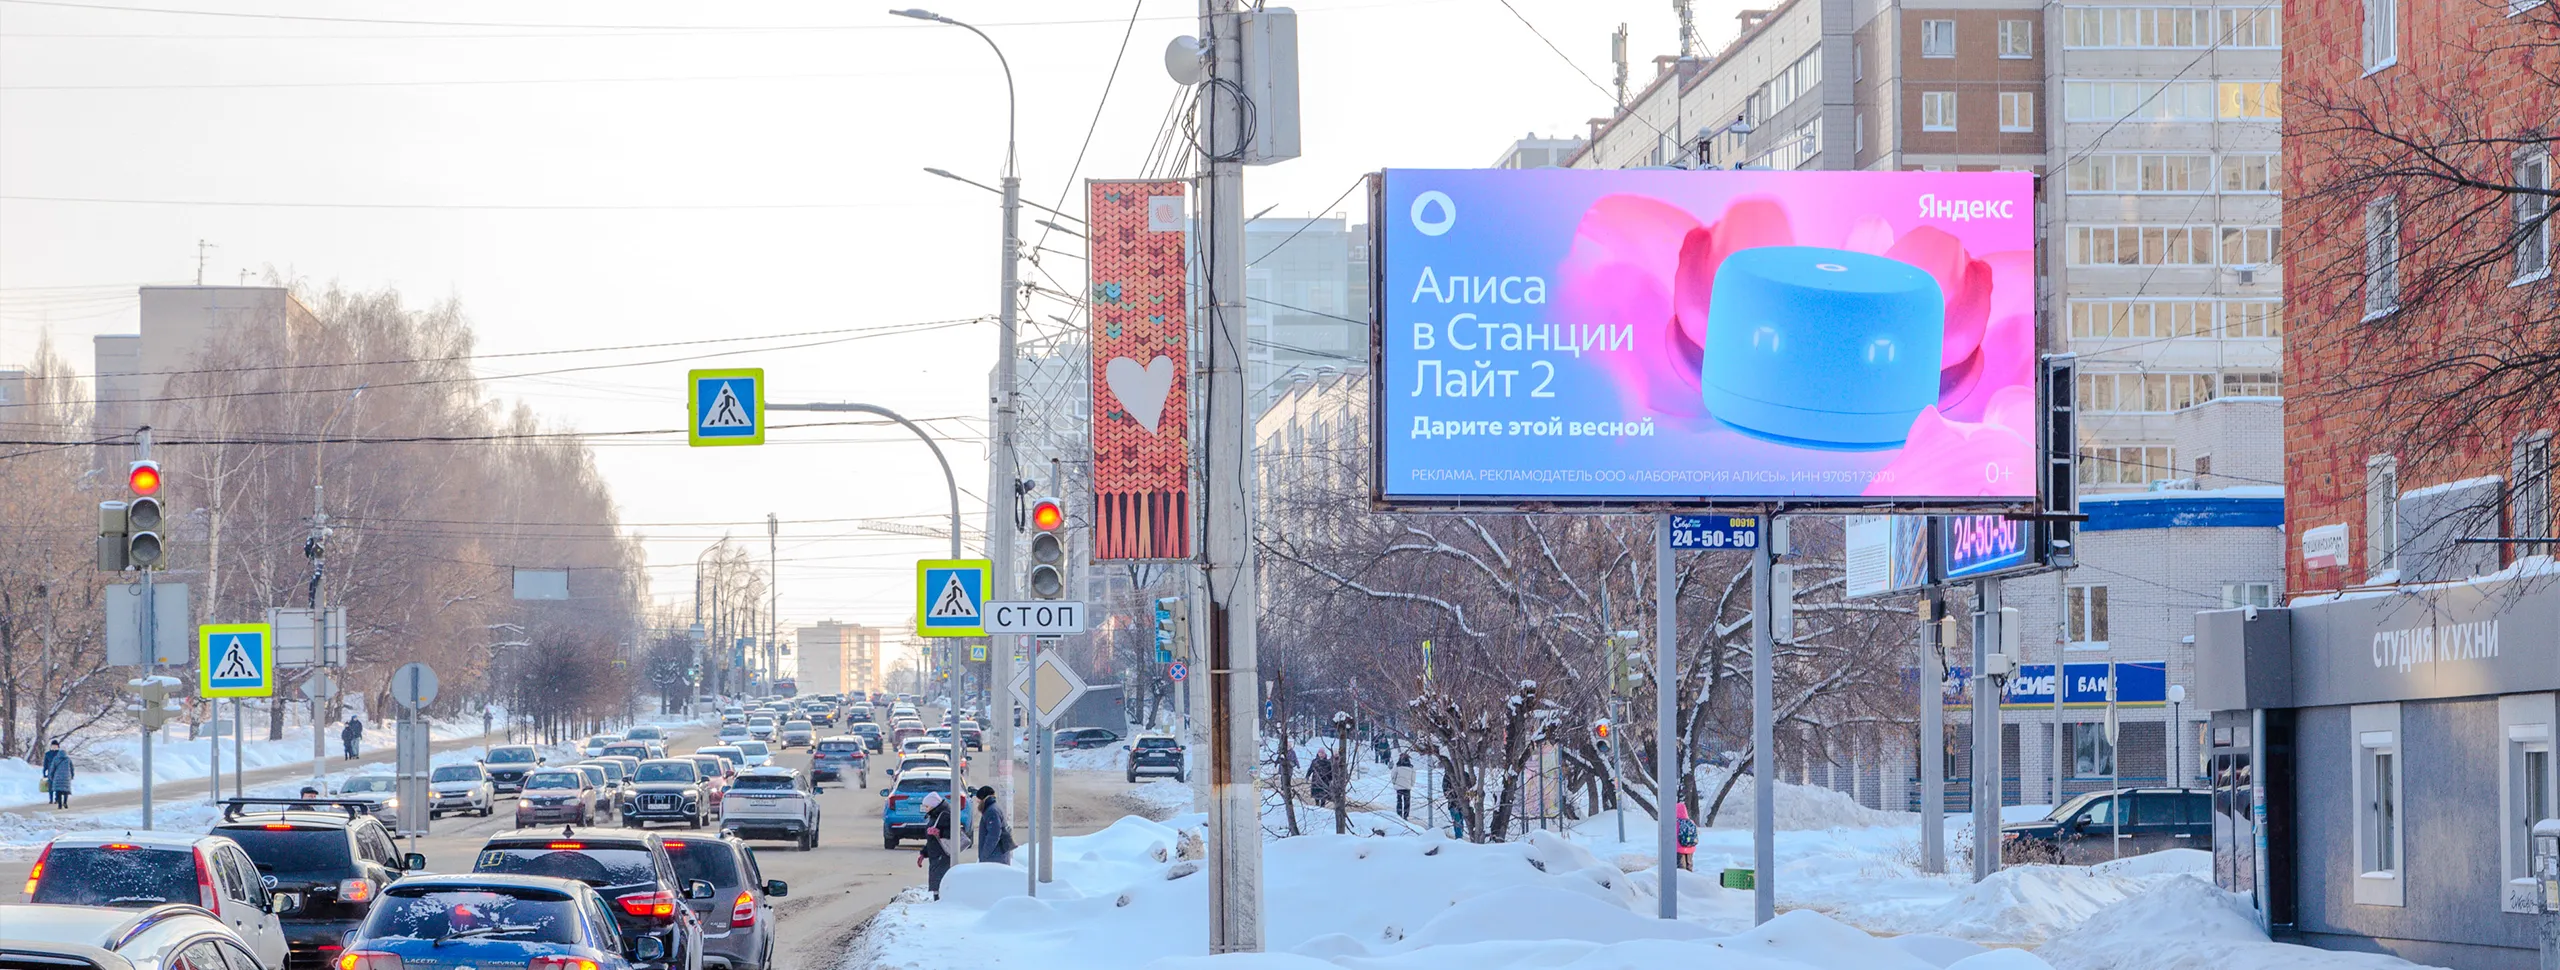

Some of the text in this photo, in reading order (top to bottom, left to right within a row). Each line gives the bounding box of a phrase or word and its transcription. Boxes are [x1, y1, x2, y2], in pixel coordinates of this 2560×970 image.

[1918, 193, 2013, 222] Яндекс
[1411, 266, 1546, 304] Алиса
[1413, 313, 1634, 358] в Станции
[1411, 360, 1556, 398] Лайт 2
[1411, 416, 1655, 440] Дарите этой весной
[1411, 469, 1477, 481] РЕКЛАМА.
[1480, 469, 1593, 483] РЕКЛАМОДАТЕЛЬ
[1595, 470, 1626, 482] ООО
[1628, 470, 1729, 482] «ЛАБОРАТОРИЯ
[1732, 470, 1789, 483] АЛИСЫ».
[1791, 470, 1820, 483] ИНН
[1985, 462, 2014, 483] 0+
[1672, 529, 1756, 547] 24-50-50
[1954, 515, 2018, 561] 24-50-50
[997, 606, 1073, 627] СТОП
[2373, 620, 2499, 673] СТУДИЯ КУХНИ
